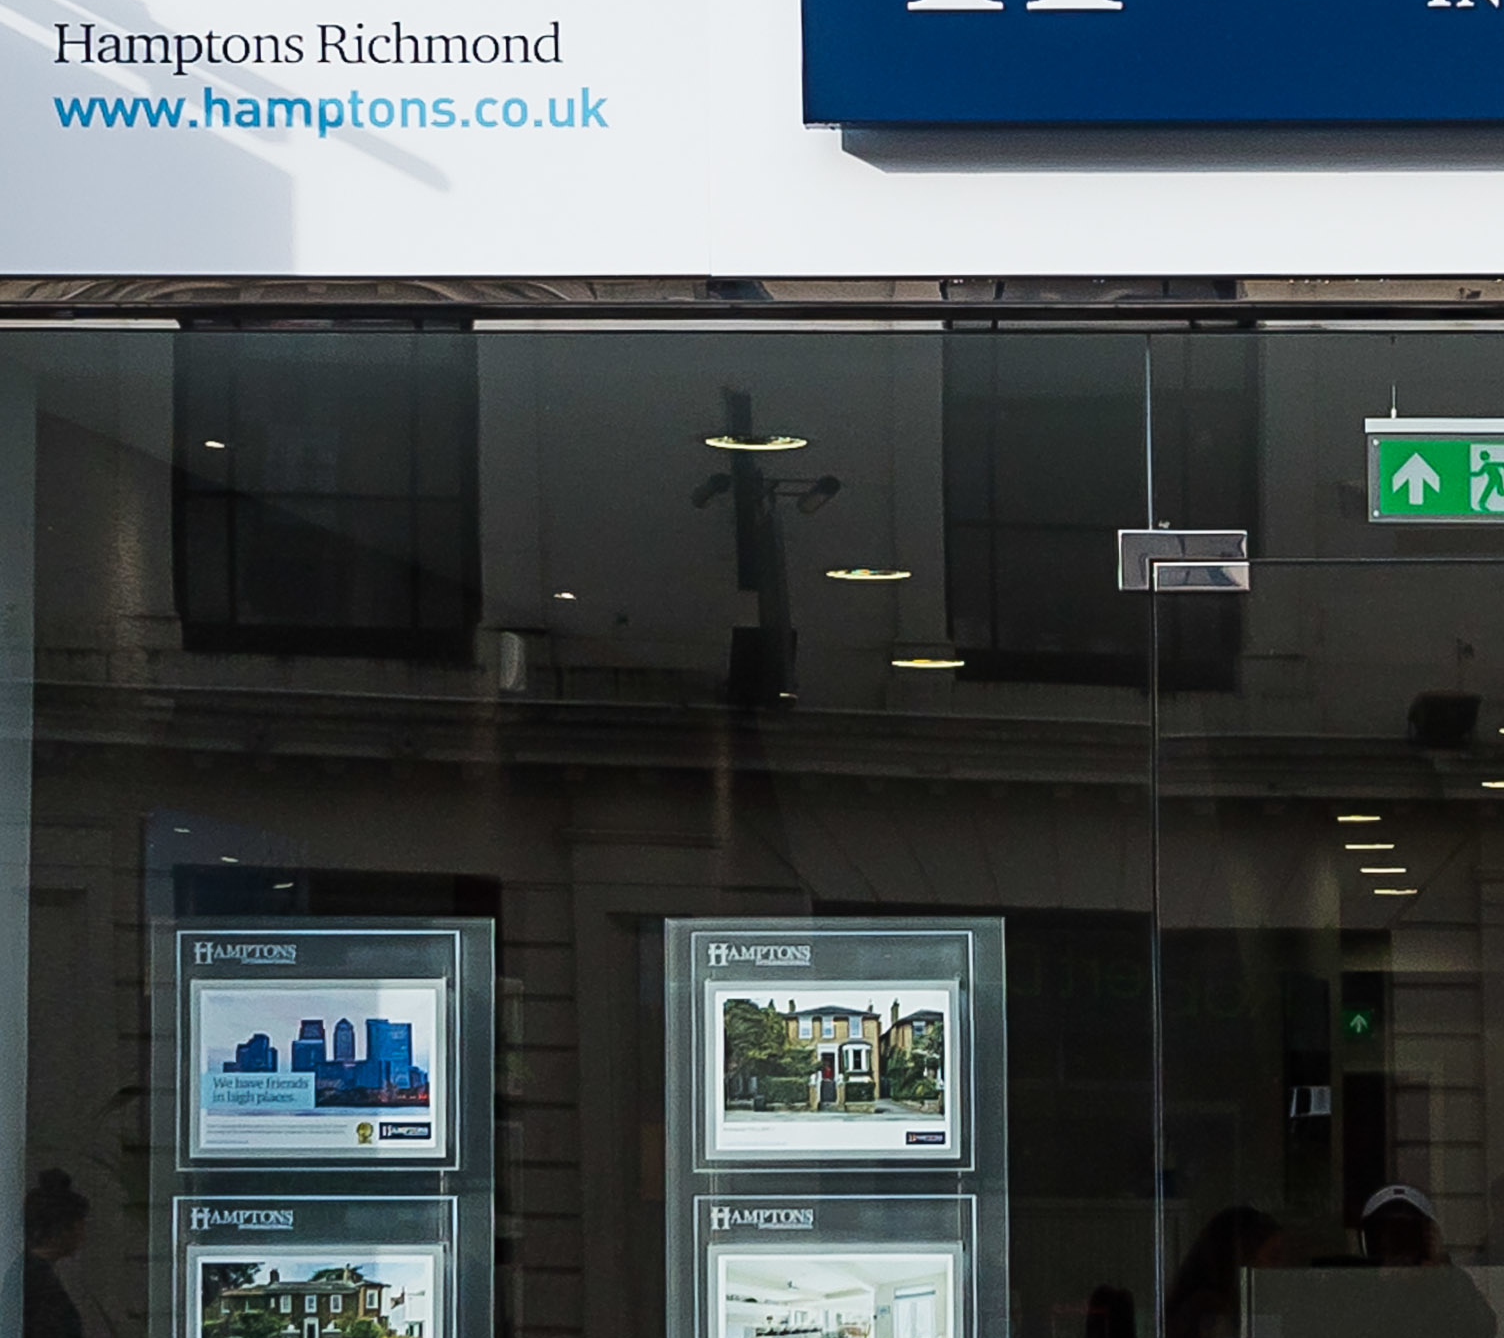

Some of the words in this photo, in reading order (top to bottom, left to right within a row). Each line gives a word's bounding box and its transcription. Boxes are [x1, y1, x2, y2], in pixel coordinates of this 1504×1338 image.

[54, 22, 304, 75] Hamptons
[316, 21, 563, 64] Richmond
[53, 87, 610, 138] www.hamptons.co.uk
[194, 941, 297, 964] HAMPTONS
[708, 942, 811, 967] HAMPTONS
[213, 1077, 233, 1089] We
[235, 1077, 262, 1089] have
[265, 1076, 309, 1089] friends
[213, 1091, 224, 1102] in
[227, 1091, 253, 1104] high
[190, 1207, 294, 1230] HAMPTONS
[711, 1206, 814, 1230] HAMPTONS
